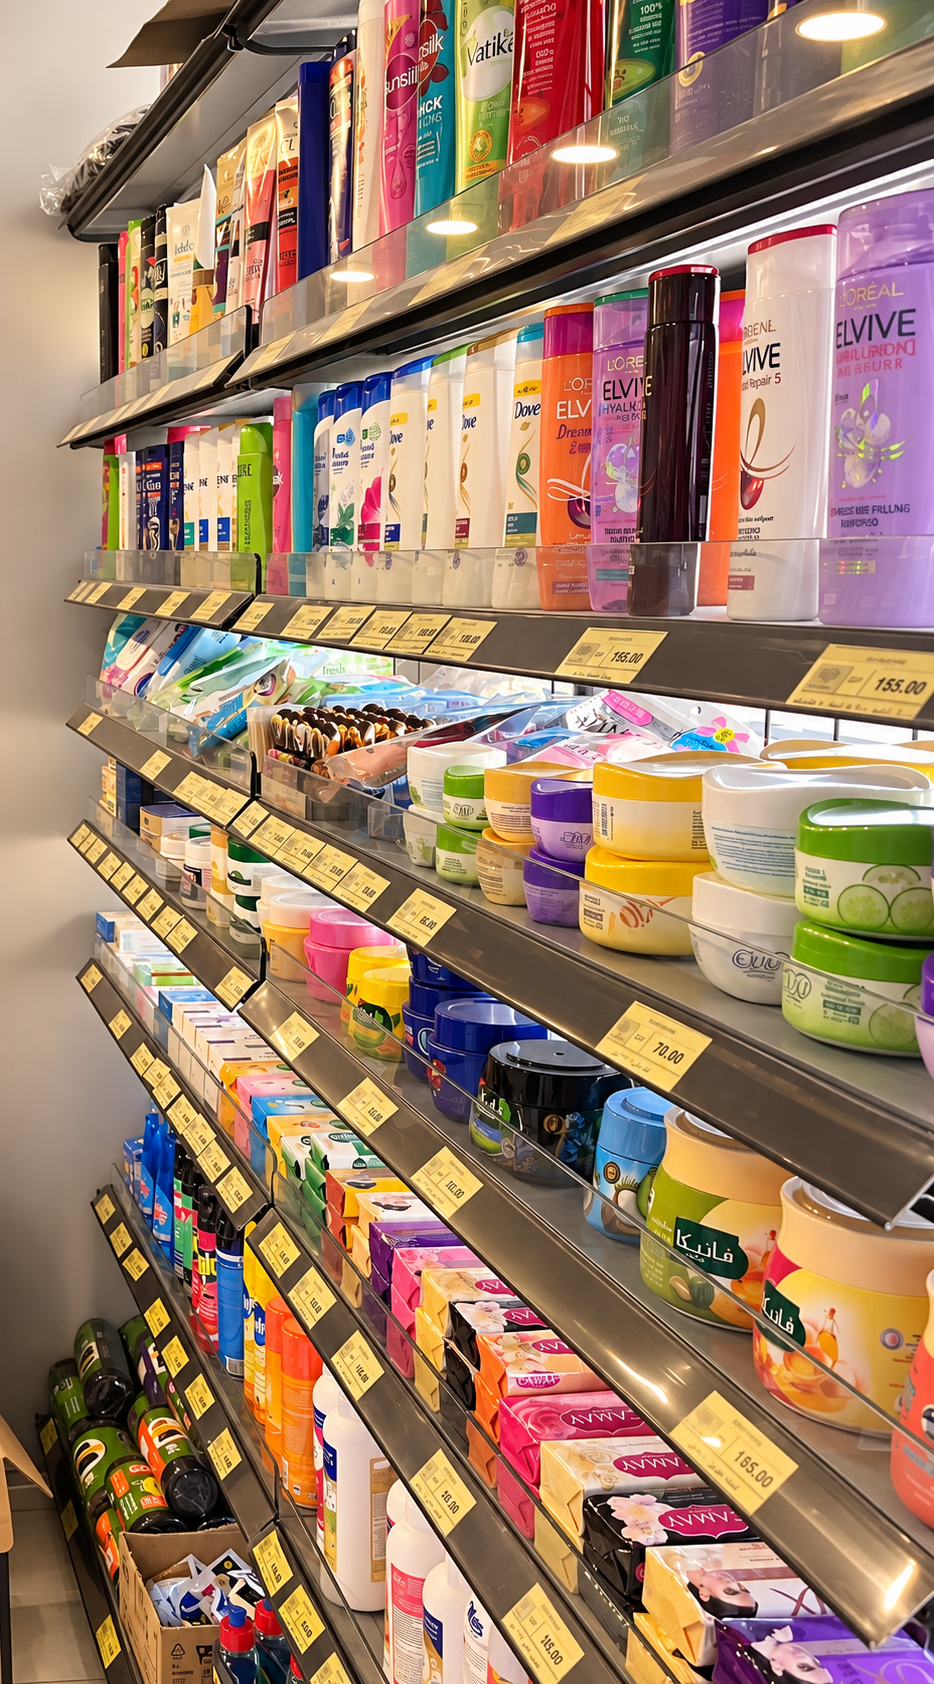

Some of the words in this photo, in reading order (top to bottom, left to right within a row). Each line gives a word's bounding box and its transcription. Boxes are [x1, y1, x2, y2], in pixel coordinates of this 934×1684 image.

[836, 308, 916, 349] ELVIVE
[774, 372, 782, 385] 5
[515, 401, 541, 419] Dove
[874, 677, 927, 696] 155.00
[652, 1041, 685, 1065] 70.00
[676, 1228, 734, 1263] فانيكا
[734, 1450, 774, 1488] 165.00
